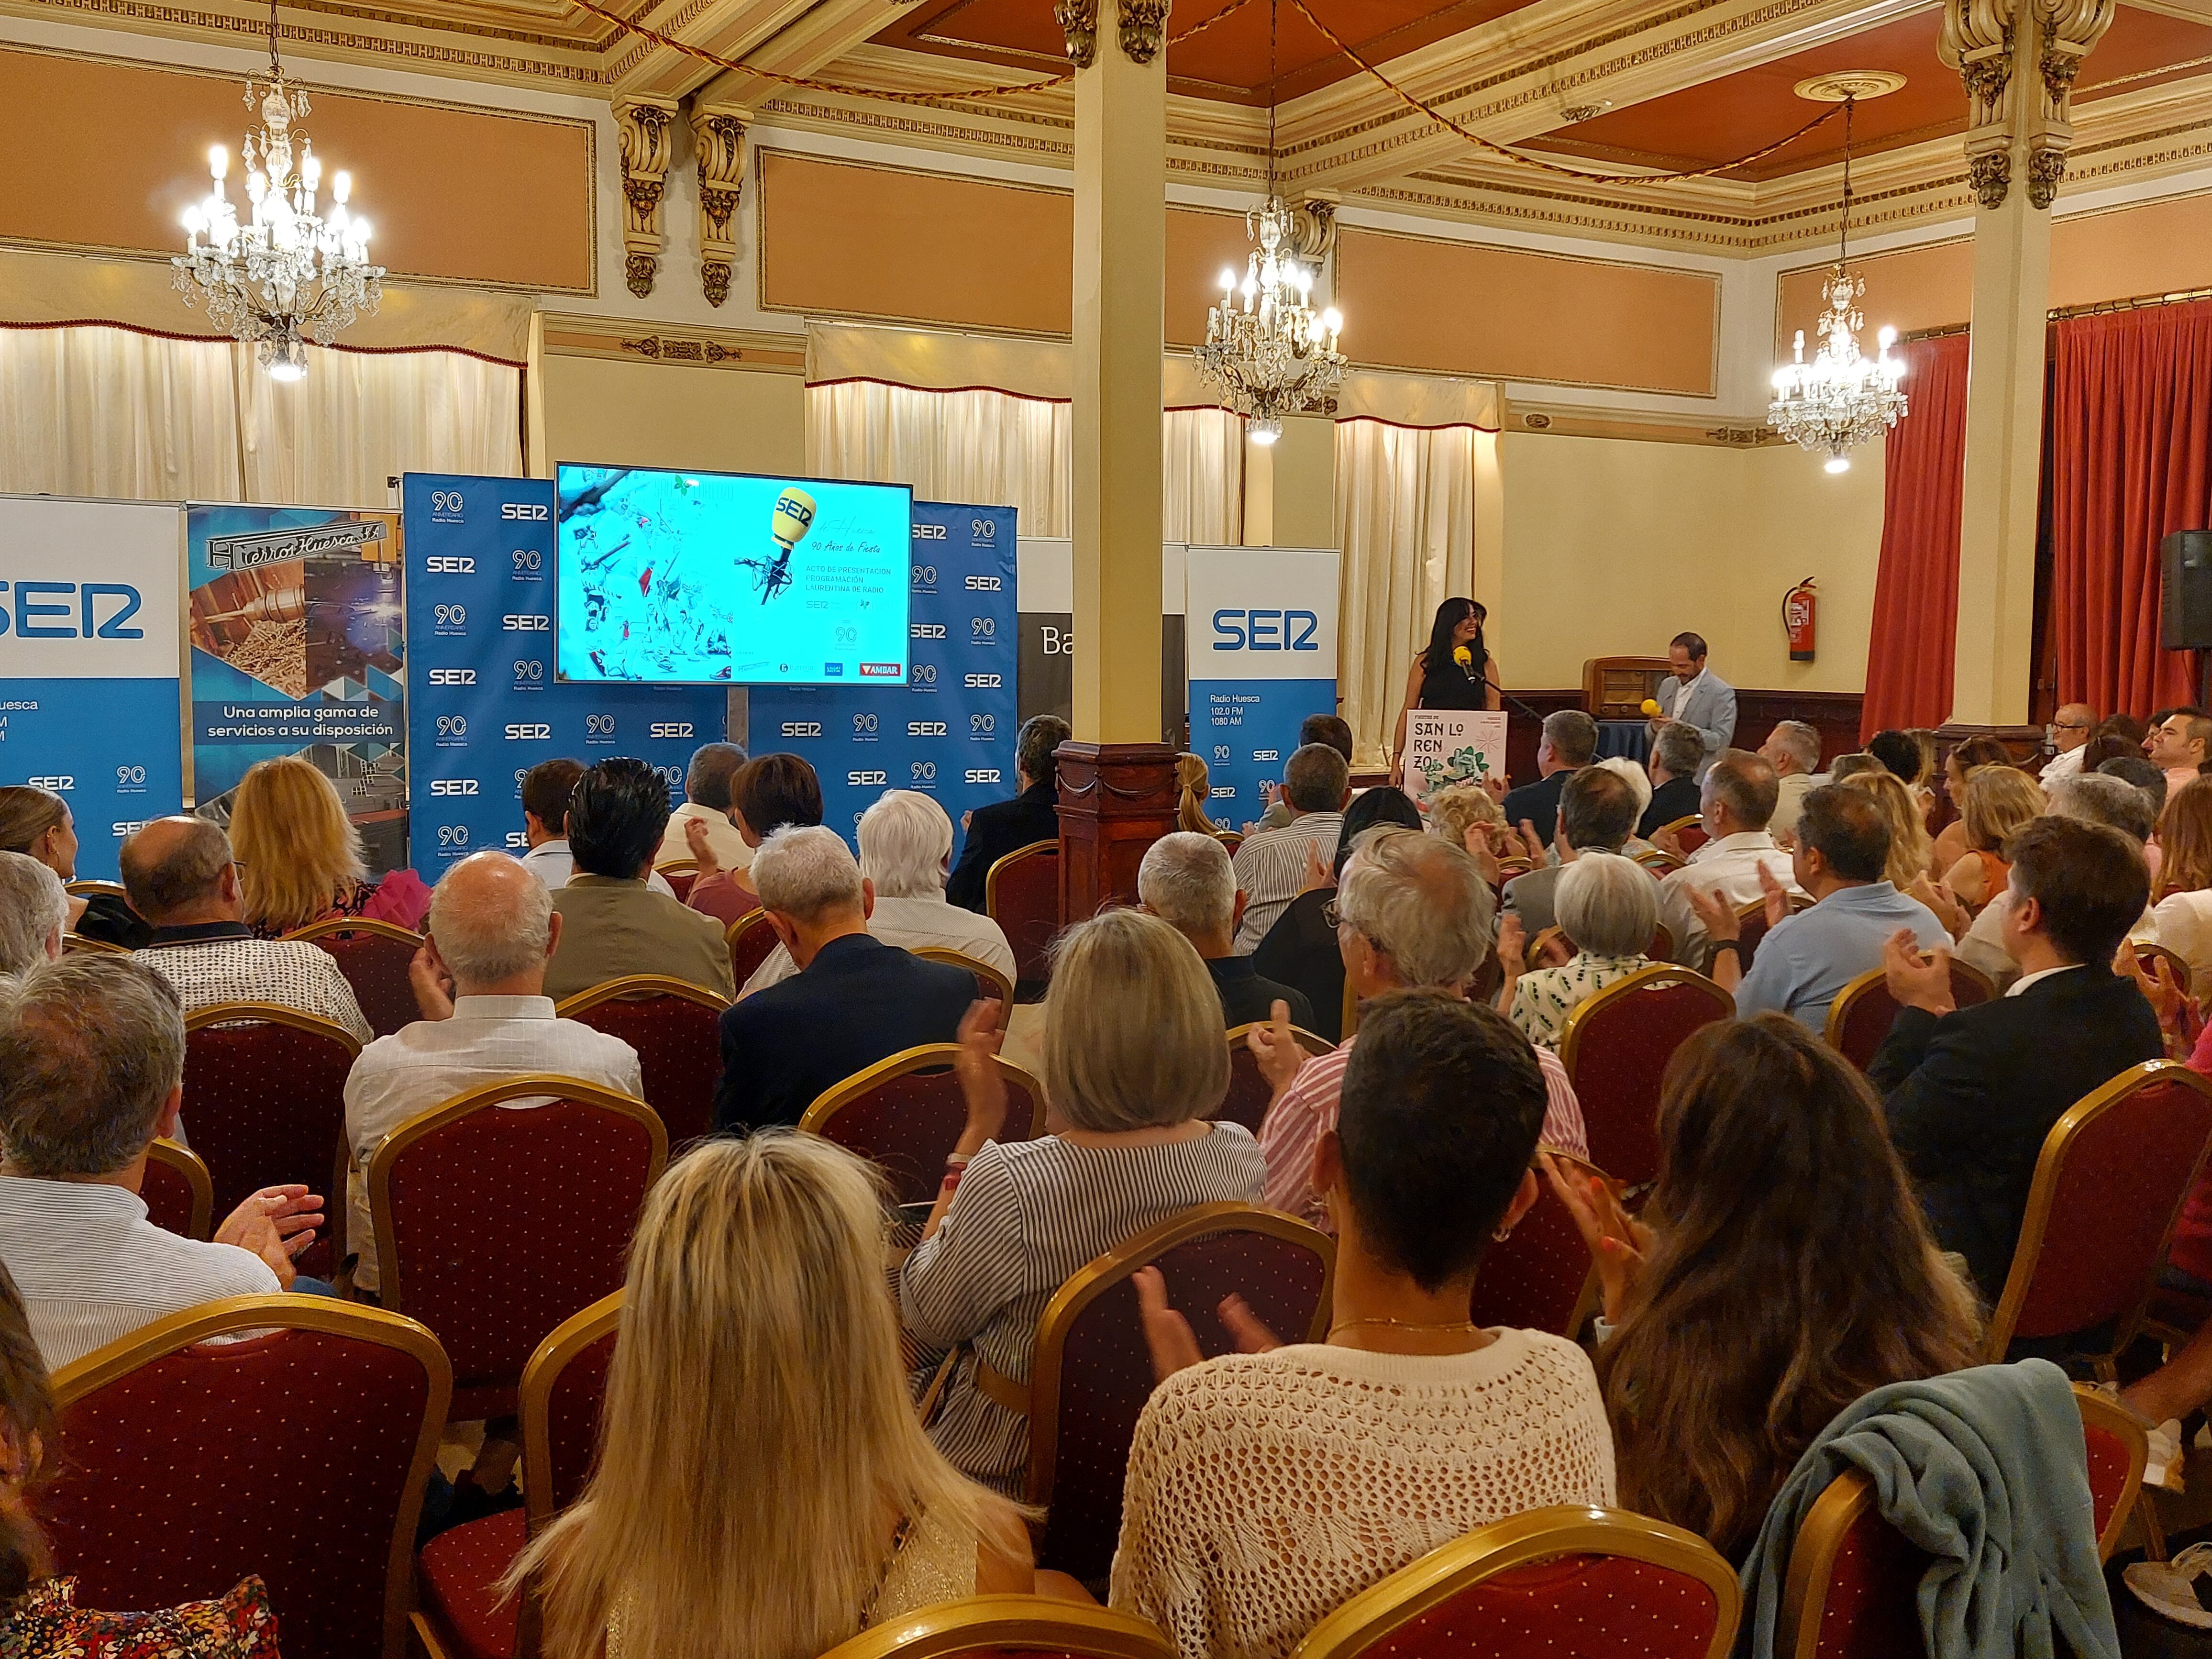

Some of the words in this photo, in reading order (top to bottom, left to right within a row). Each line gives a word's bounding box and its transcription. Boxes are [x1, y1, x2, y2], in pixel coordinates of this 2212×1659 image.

[431, 491, 463, 512] 90
[501, 503, 548, 520] SER
[776, 497, 812, 527] SER
[912, 524, 946, 540] SER
[972, 519, 995, 538] 90
[812, 542, 821, 550] 90
[846, 542, 854, 552] de
[206, 539, 294, 572] Hierros
[512, 550, 541, 570] 90
[426, 556, 475, 573] SER
[912, 565, 936, 584] 90
[965, 576, 1001, 591] SER
[0, 581, 144, 639] ER
[806, 600, 828, 608] SER
[434, 605, 466, 624] 90
[503, 615, 549, 630] SER
[836, 627, 857, 642] 90
[910, 624, 946, 639] SER
[972, 618, 995, 636] 90
[1213, 609, 1318, 651] SER
[429, 669, 476, 685] SER
[514, 660, 542, 680] 90
[870, 665, 898, 675] AMBAR
[912, 665, 936, 683] 90
[964, 674, 1001, 688] SER
[1210, 695, 1230, 703] Radio
[1232, 694, 1260, 703] Huesca
[223, 706, 256, 718] Una
[258, 705, 310, 720] amplia
[313, 708, 358, 722] gama
[360, 706, 378, 718] de
[1211, 707, 1230, 715] 102.0
[1232, 707, 1243, 715] FM
[436, 716, 466, 736] 90
[586, 714, 615, 733] 90
[781, 722, 821, 737] SER
[853, 714, 878, 732] 90
[907, 722, 947, 736] SER
[970, 714, 994, 731] 90
[1211, 717, 1228, 726] 1080
[1229, 717, 1242, 726] AM
[1415, 723, 1444, 735] SAN
[208, 724, 275, 737] servicios
[278, 726, 288, 736] a
[292, 726, 309, 736] su
[312, 723, 393, 738] disposición
[505, 724, 551, 740] SER
[650, 723, 694, 738] SER
[1214, 745, 1230, 759] 90
[1414, 740, 1442, 752] REN
[1253, 750, 1279, 761] SER
[1413, 756, 1432, 768] ZO
[117, 765, 145, 784] 90
[848, 771, 887, 785] SER
[911, 762, 936, 779] 90
[965, 770, 1000, 784] SER
[514, 769, 528, 789] 9
[1259, 780, 1275, 793] 90
[430, 780, 479, 796] SER
[1211, 787, 1236, 798] SER
[438, 826, 468, 845] 90
